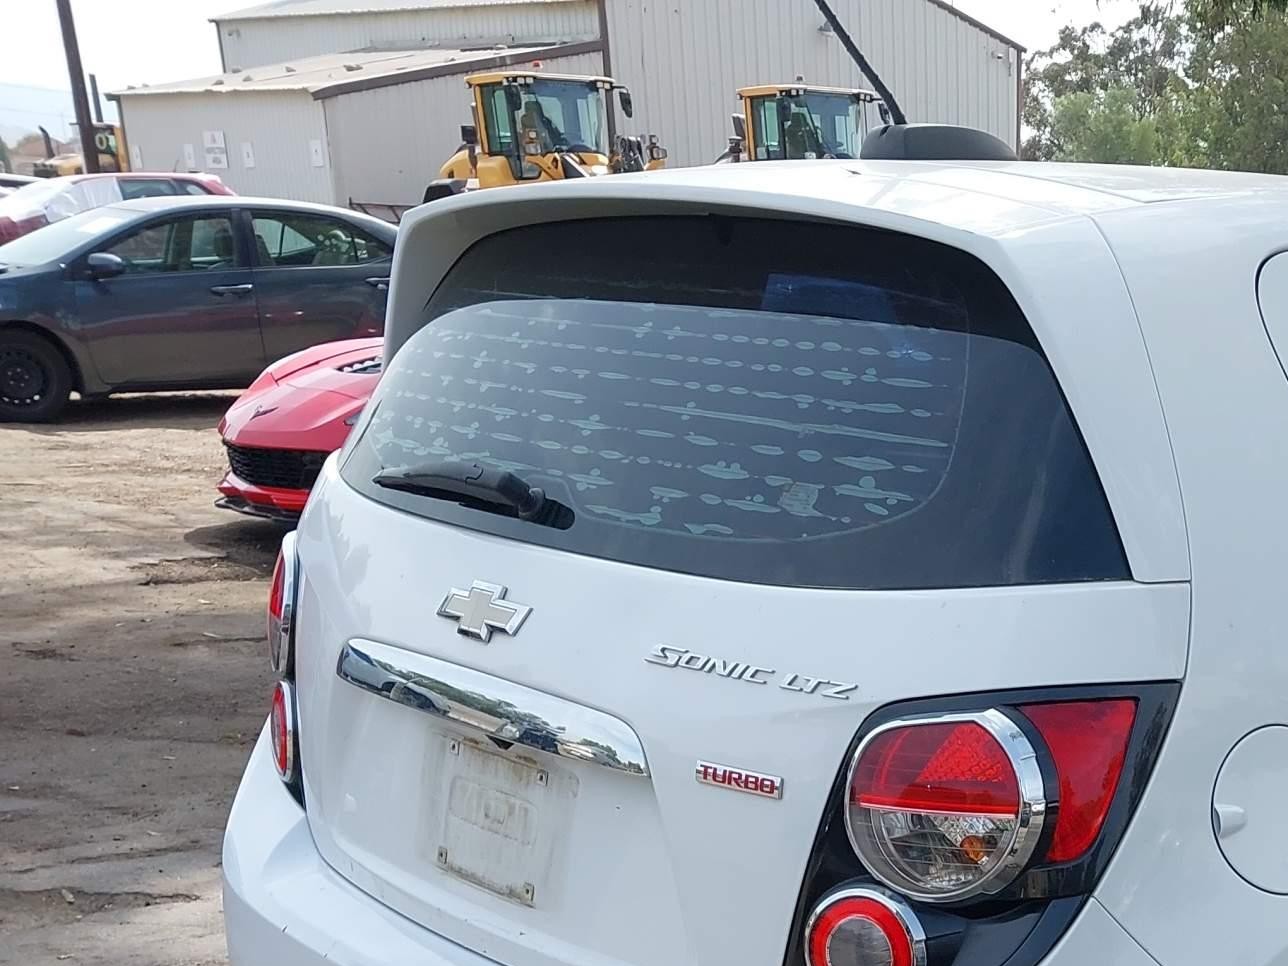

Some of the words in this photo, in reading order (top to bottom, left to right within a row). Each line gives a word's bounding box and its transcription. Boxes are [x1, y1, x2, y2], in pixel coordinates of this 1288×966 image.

[644, 643, 776, 685] SONIC
[779, 672, 859, 701] LTZ
[699, 763, 778, 795] TURBO
